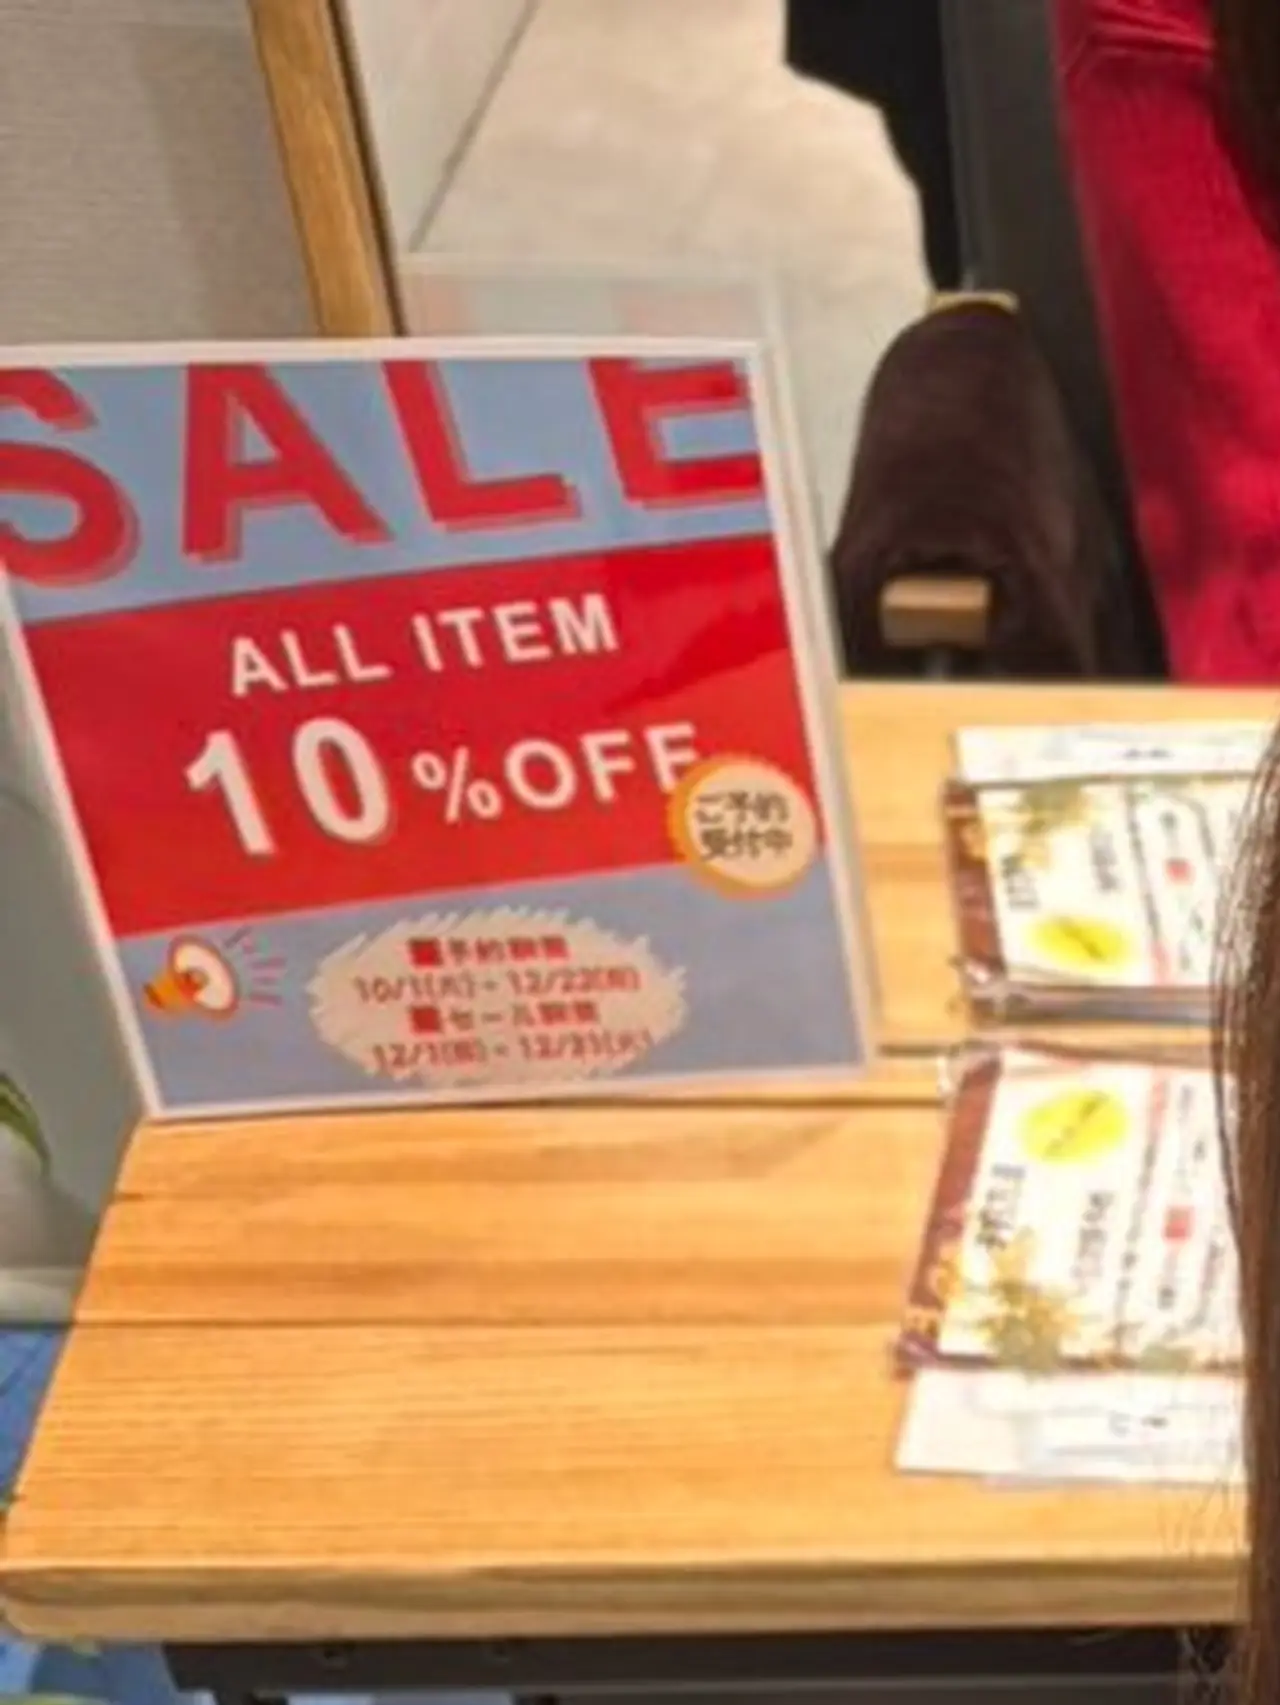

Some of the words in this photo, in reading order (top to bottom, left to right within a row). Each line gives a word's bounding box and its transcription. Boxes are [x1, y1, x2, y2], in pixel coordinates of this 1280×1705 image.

[0, 358, 766, 588] SALE
[230, 624, 393, 698] ALL
[411, 593, 619, 673] ITEM
